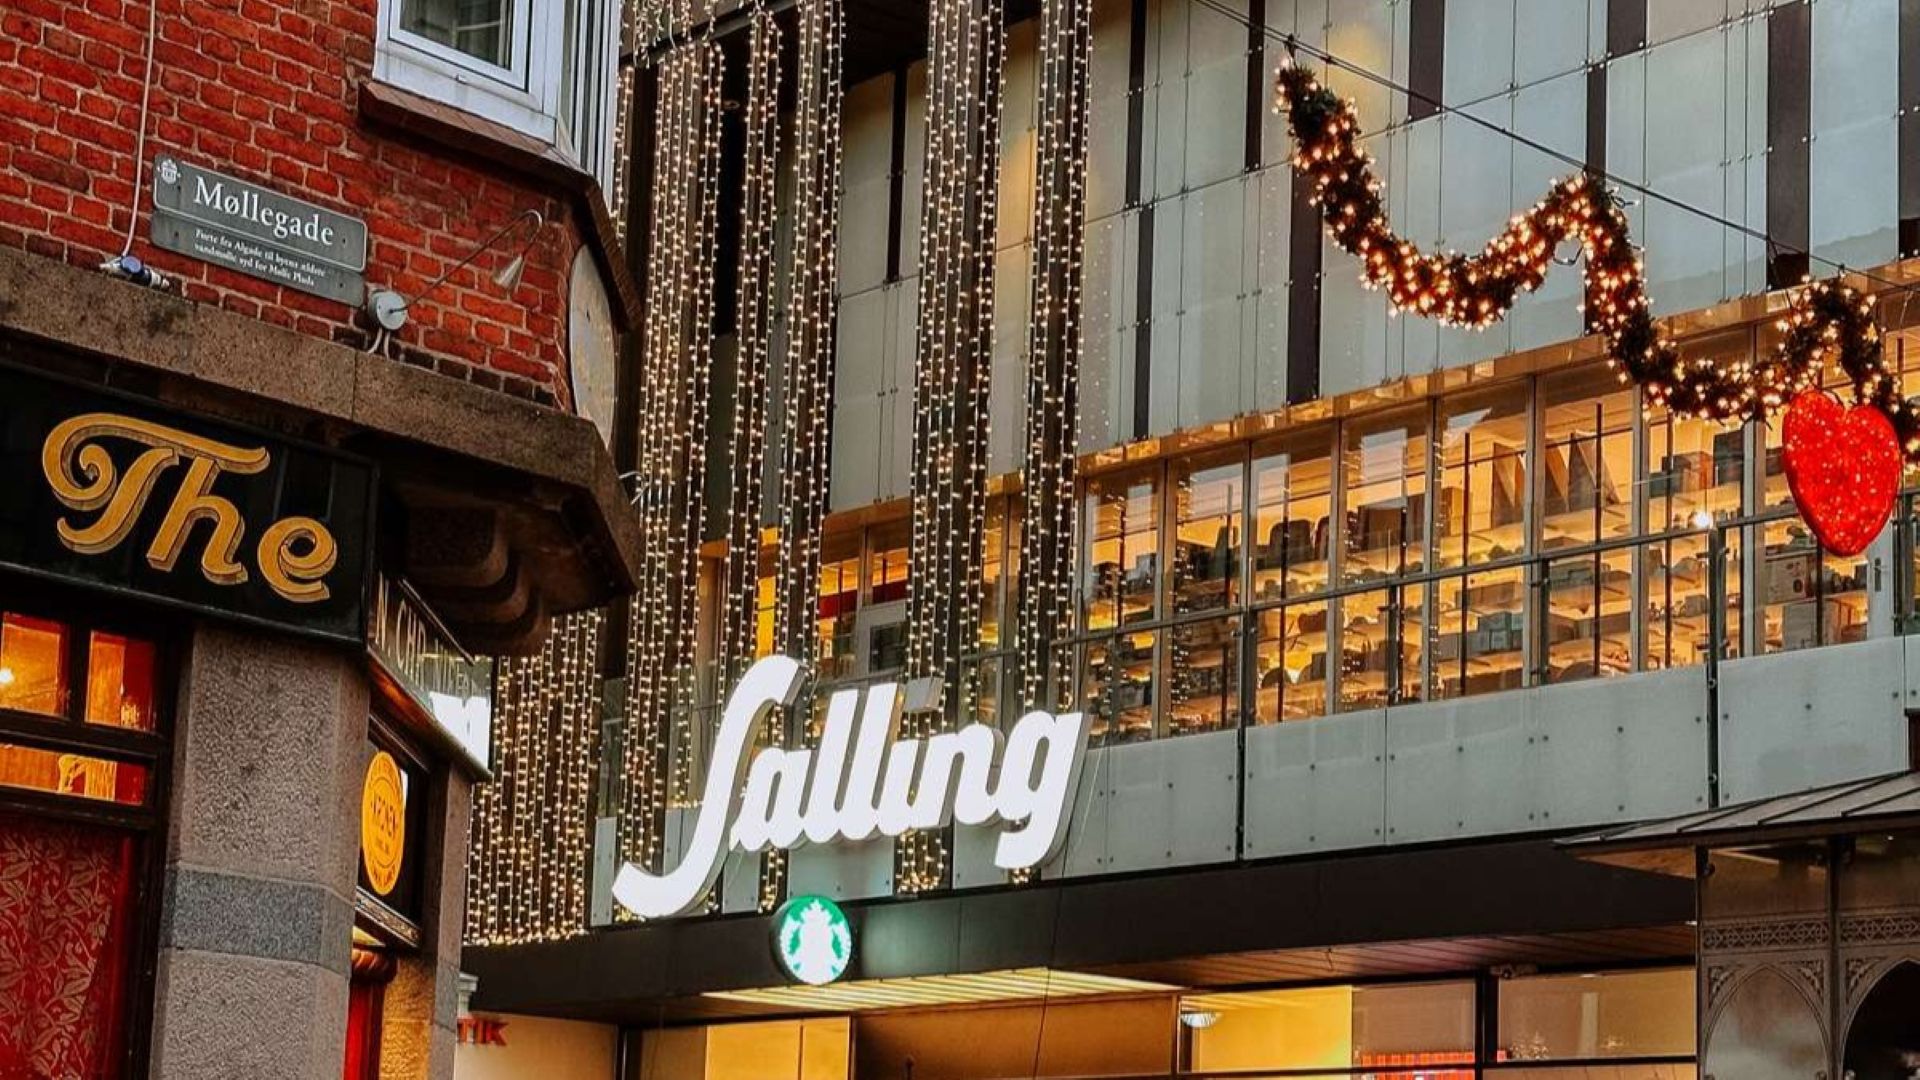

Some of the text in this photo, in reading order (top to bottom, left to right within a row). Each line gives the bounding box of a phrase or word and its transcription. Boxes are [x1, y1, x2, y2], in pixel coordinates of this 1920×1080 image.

[193, 175, 334, 246] Møllegade
[43, 412, 338, 603] The
[612, 655, 1088, 918] Salling
